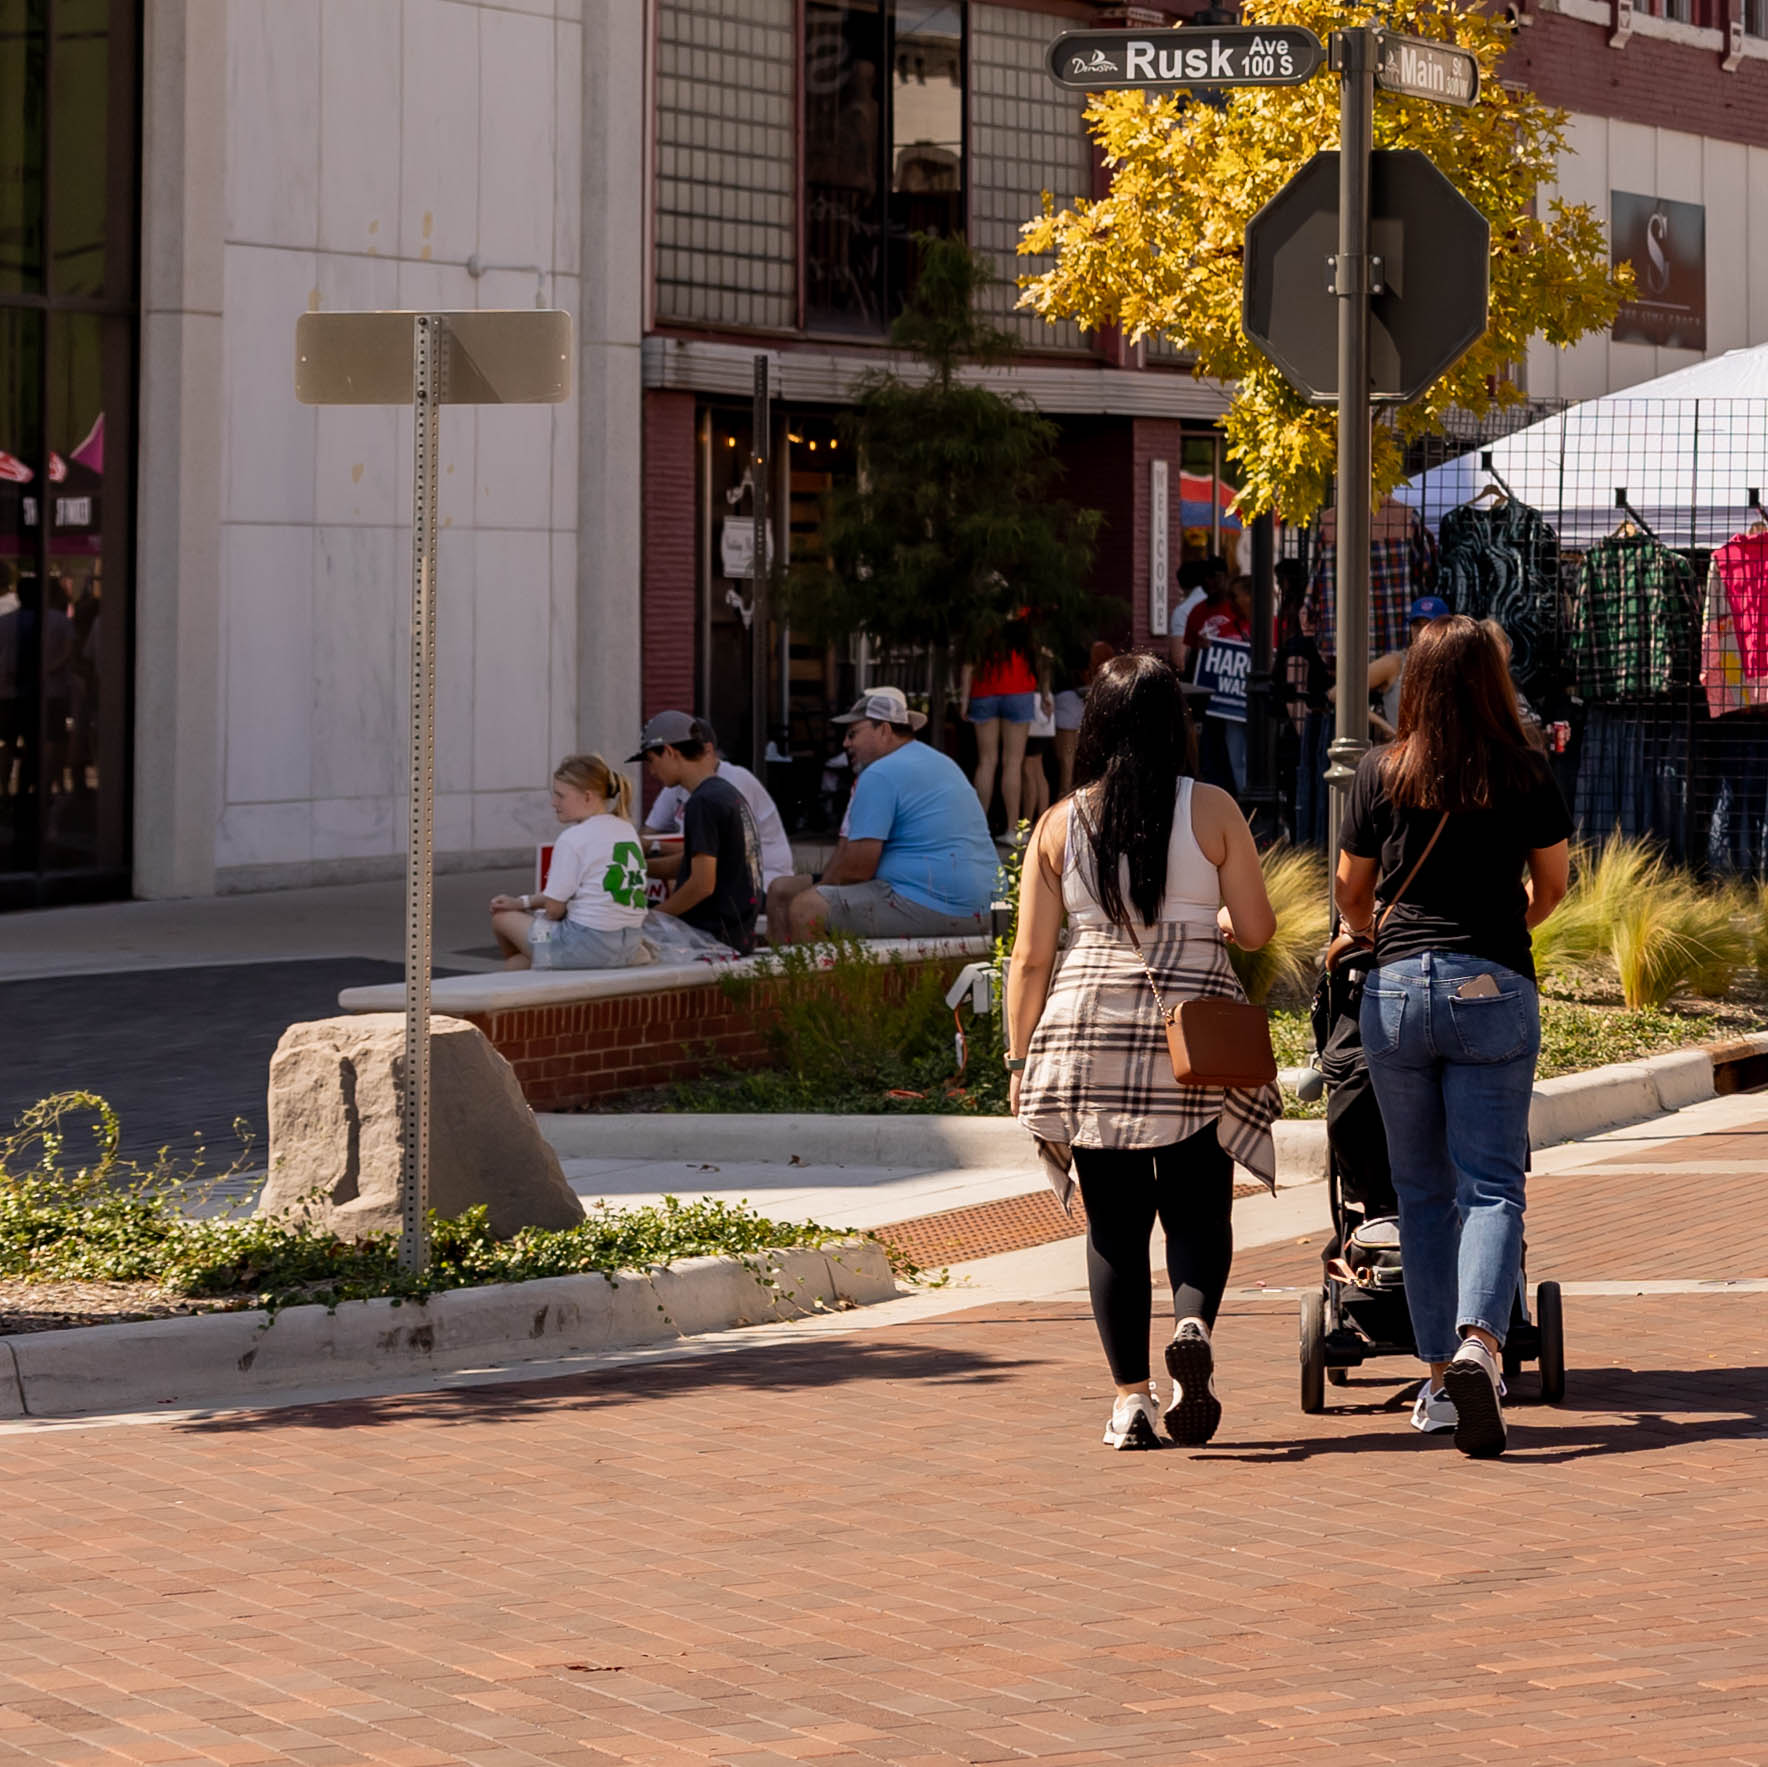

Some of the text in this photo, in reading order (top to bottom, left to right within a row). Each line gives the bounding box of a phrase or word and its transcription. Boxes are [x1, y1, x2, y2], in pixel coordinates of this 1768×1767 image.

[1126, 39, 1235, 80] Rusk
[1242, 55, 1293, 77] 100 S
[1249, 36, 1289, 56] Ave
[1401, 45, 1444, 92] Main
[1155, 468, 1166, 627] WELCOME
